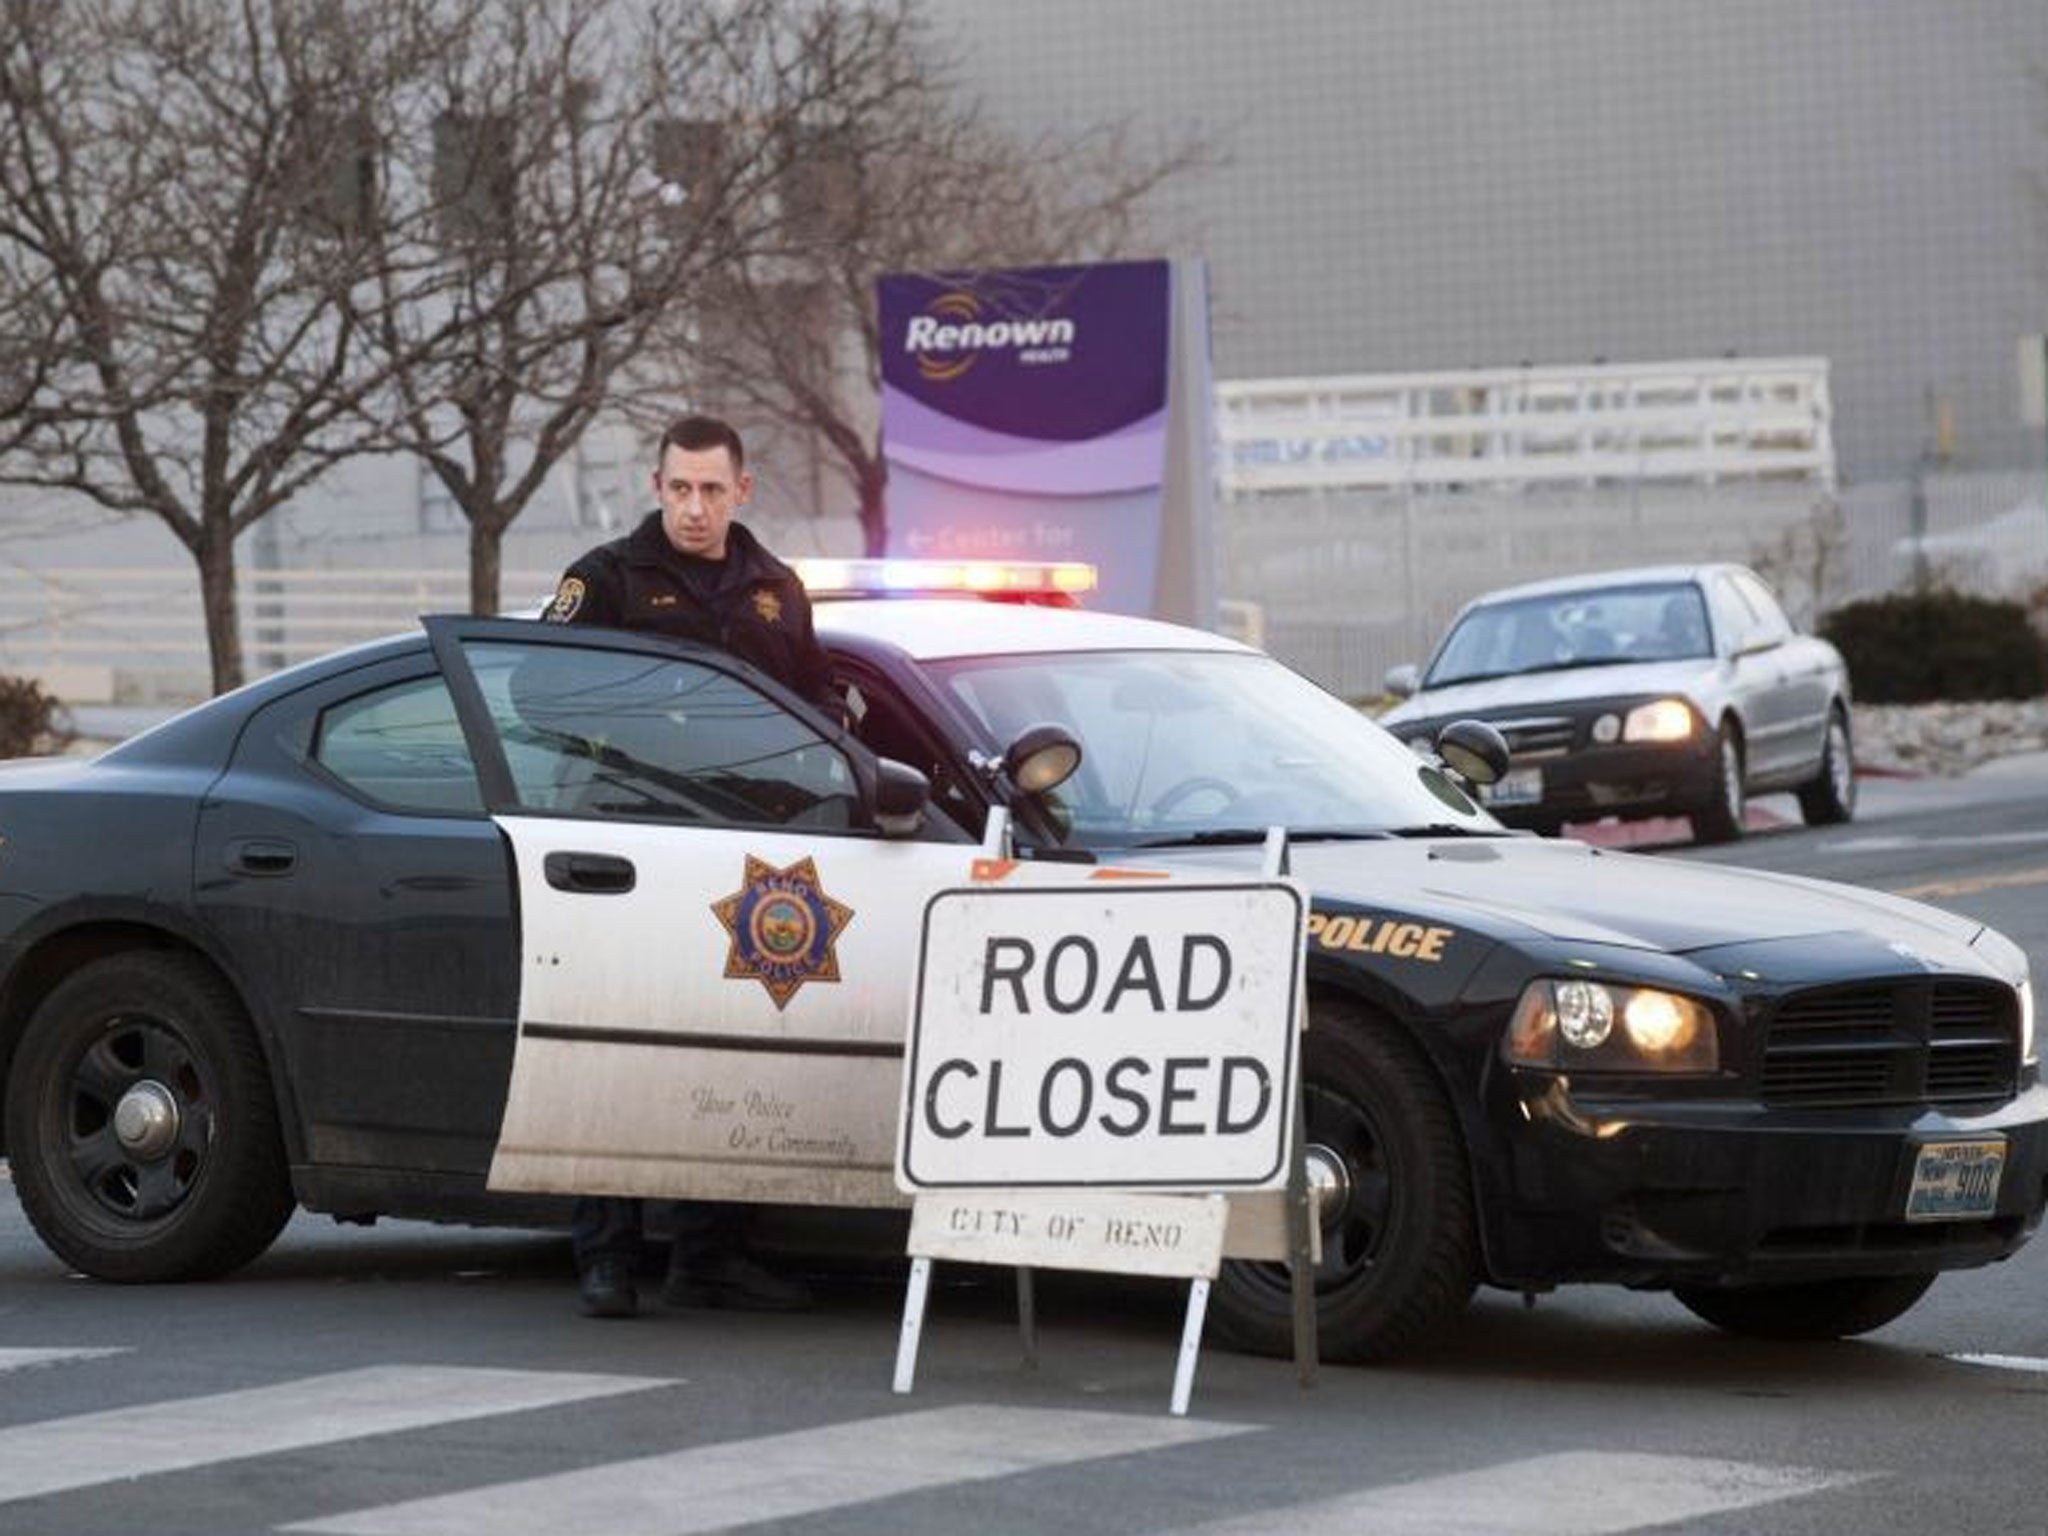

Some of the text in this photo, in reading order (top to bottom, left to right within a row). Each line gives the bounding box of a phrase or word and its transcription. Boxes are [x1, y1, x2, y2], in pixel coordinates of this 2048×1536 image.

[906, 316, 1075, 351] Renown
[1308, 912, 1454, 962] POLICE
[980, 934, 1232, 1014] ROAD
[925, 1057, 1272, 1139] CLOSED
[950, 1207, 1182, 1250] CITY OF RENO
